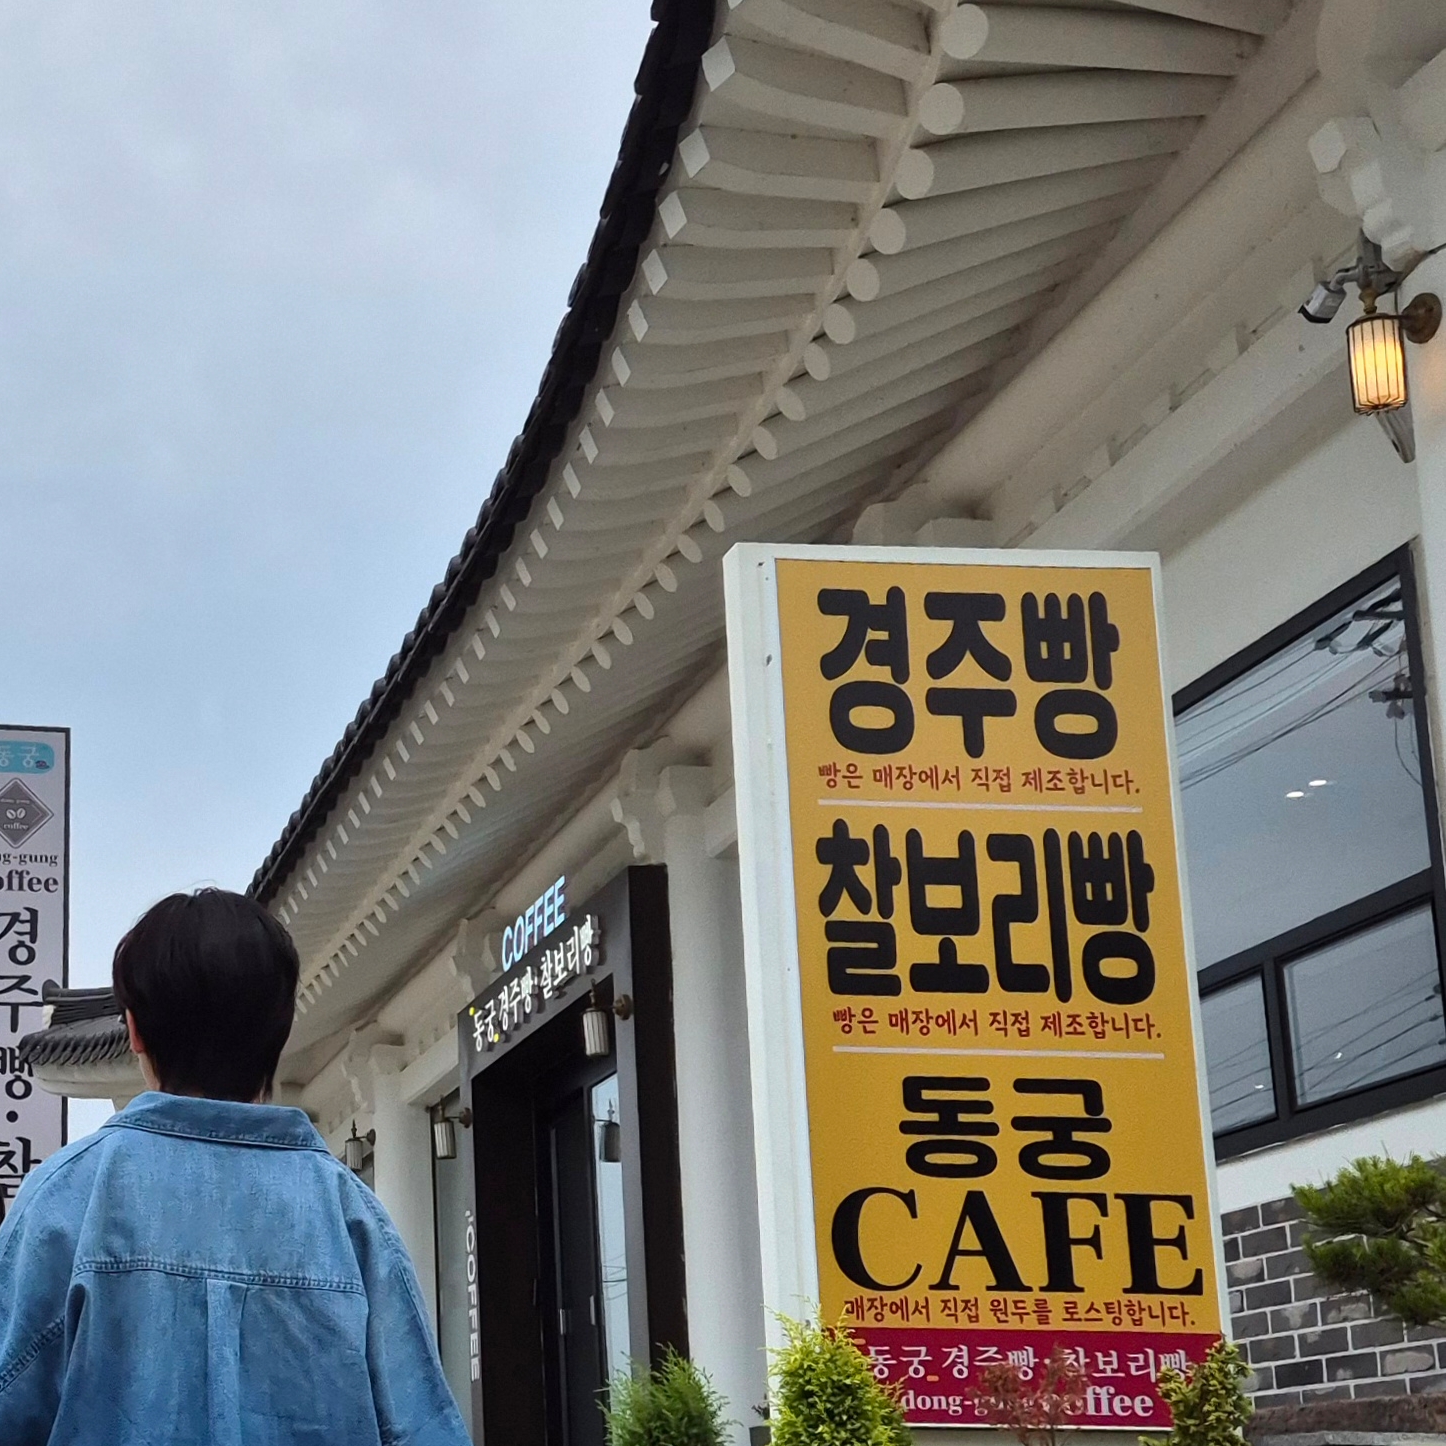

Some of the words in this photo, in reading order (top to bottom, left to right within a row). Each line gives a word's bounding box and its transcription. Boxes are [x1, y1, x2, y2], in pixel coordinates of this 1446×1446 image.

[817, 585, 1120, 760] 경주빵
[818, 763, 864, 790] 빵은
[872, 765, 962, 793] 매장에서
[970, 768, 1012, 794] 직접
[1021, 770, 1142, 796] 제조합니다.
[501, 874, 566, 973] COFFEE
[814, 817, 1155, 1006] 찰보리빵
[472, 998, 497, 1052] 동궁
[833, 1008, 880, 1035] 빵은
[888, 1009, 979, 1037] 매장에서
[987, 1011, 1031, 1038] 직접
[1039, 1012, 1162, 1040] 제조합니다.
[898, 1074, 1113, 1181] 동궁
[830, 1185, 1204, 1296] CAFE
[844, 1294, 931, 1324] 매장에서
[940, 1296, 980, 1324] 직접
[989, 1298, 1053, 1326] 원두를
[1062, 1300, 1197, 1328] 로스팅합니다.
[867, 1345, 933, 1379] 동궁
